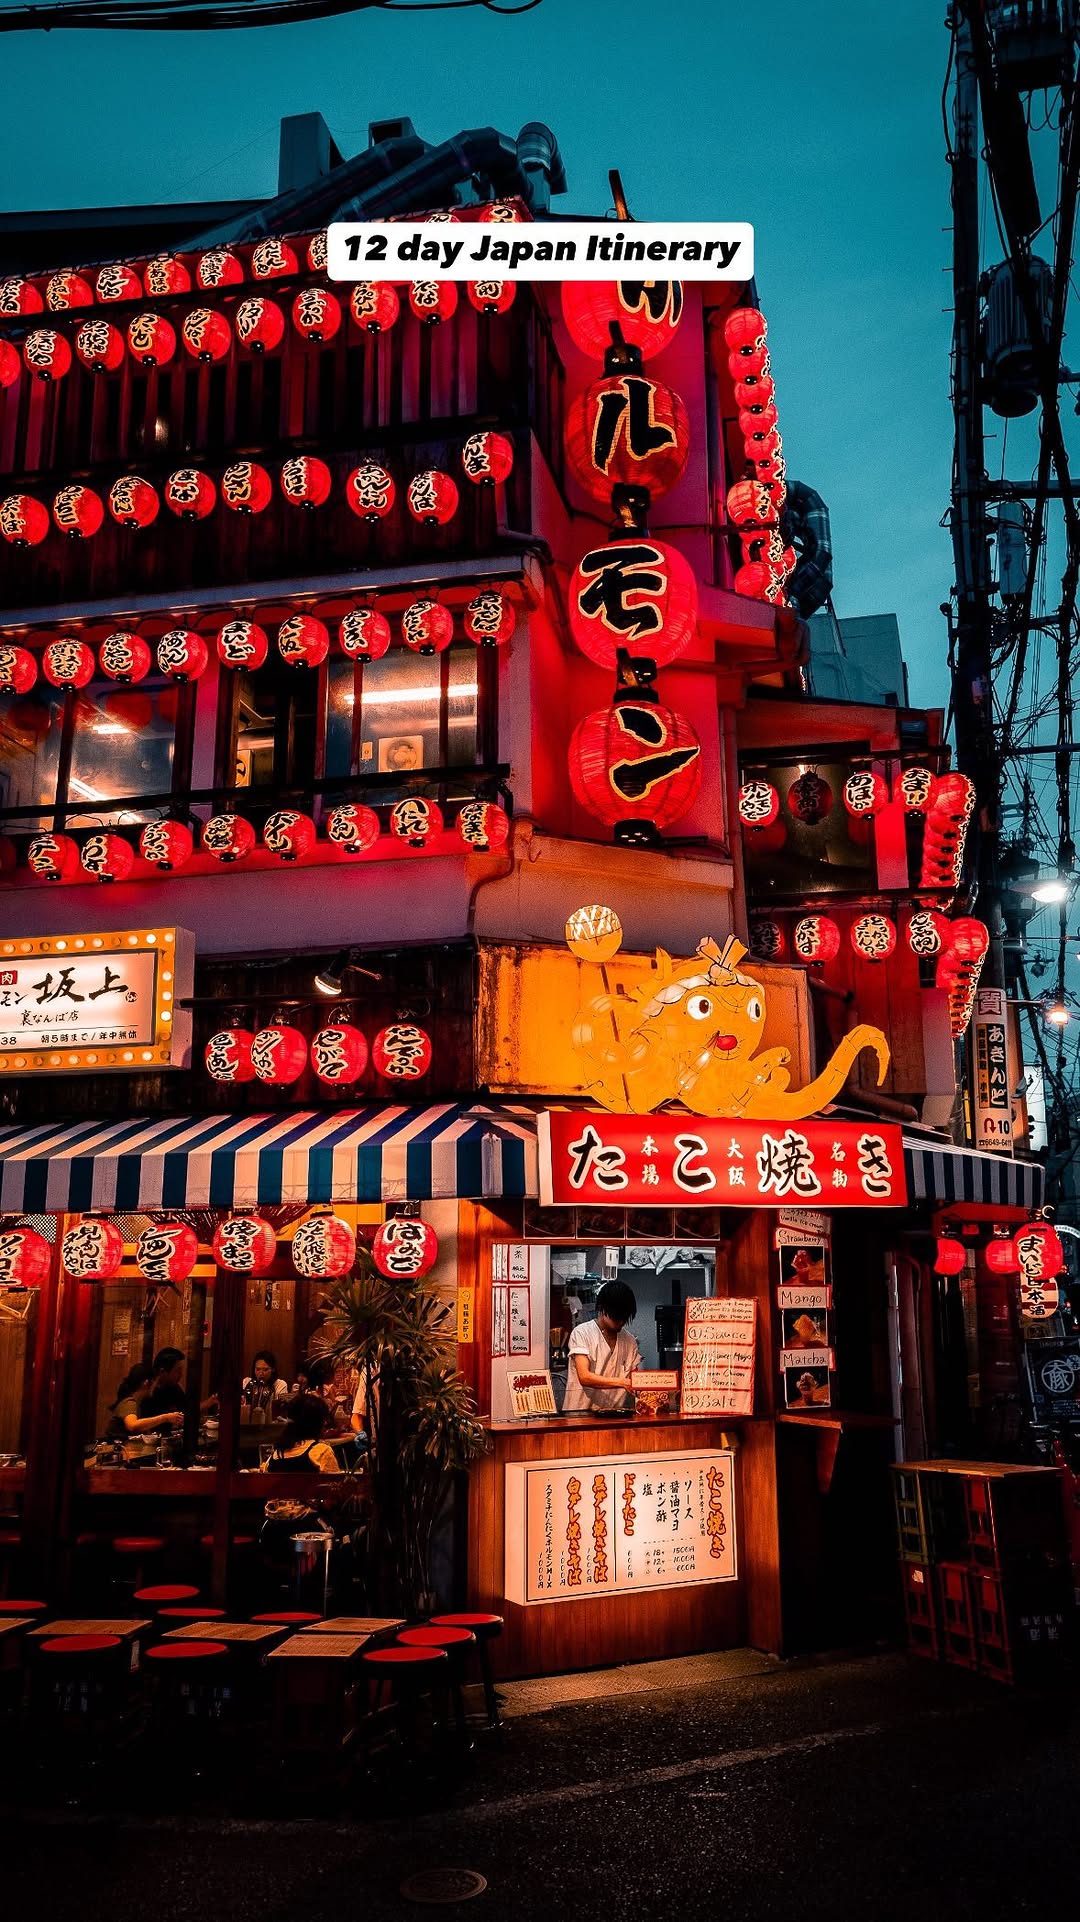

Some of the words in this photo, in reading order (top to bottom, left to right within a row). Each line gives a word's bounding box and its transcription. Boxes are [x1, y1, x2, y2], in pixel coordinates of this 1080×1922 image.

[222, 621, 255, 660] まいど
[846, 774, 874, 810] あほか
[394, 798, 430, 836] へたれ
[28, 833, 60, 872] ミナミ
[32, 966, 129, 1005] 坂上
[979, 991, 1001, 1014] 質
[20, 1009, 79, 1026] 裏なんば店
[384, 1025, 420, 1076] なんでっか
[988, 1025, 1006, 1106] あきんど
[998, 1120, 1010, 1135] 10
[567, 1124, 894, 1197] たこ焼き
[640, 1135, 661, 1185] 本場
[830, 1141, 848, 1188] 名物
[221, 1218, 261, 1269] 焼きまっせ
[387, 1221, 424, 1274] はみご
[778, 1230, 821, 1245] Strawberry
[1018, 1235, 1043, 1276] まいど
[781, 1290, 822, 1308] Mango
[783, 1354, 826, 1369] Matcha
[701, 1394, 737, 1409] Salt
[643, 1483, 653, 1496] 塩
[670, 1481, 680, 1531] 醤油マヨ
[684, 1480, 693, 1519] ソース
[706, 1466, 727, 1559] たこ焼き
